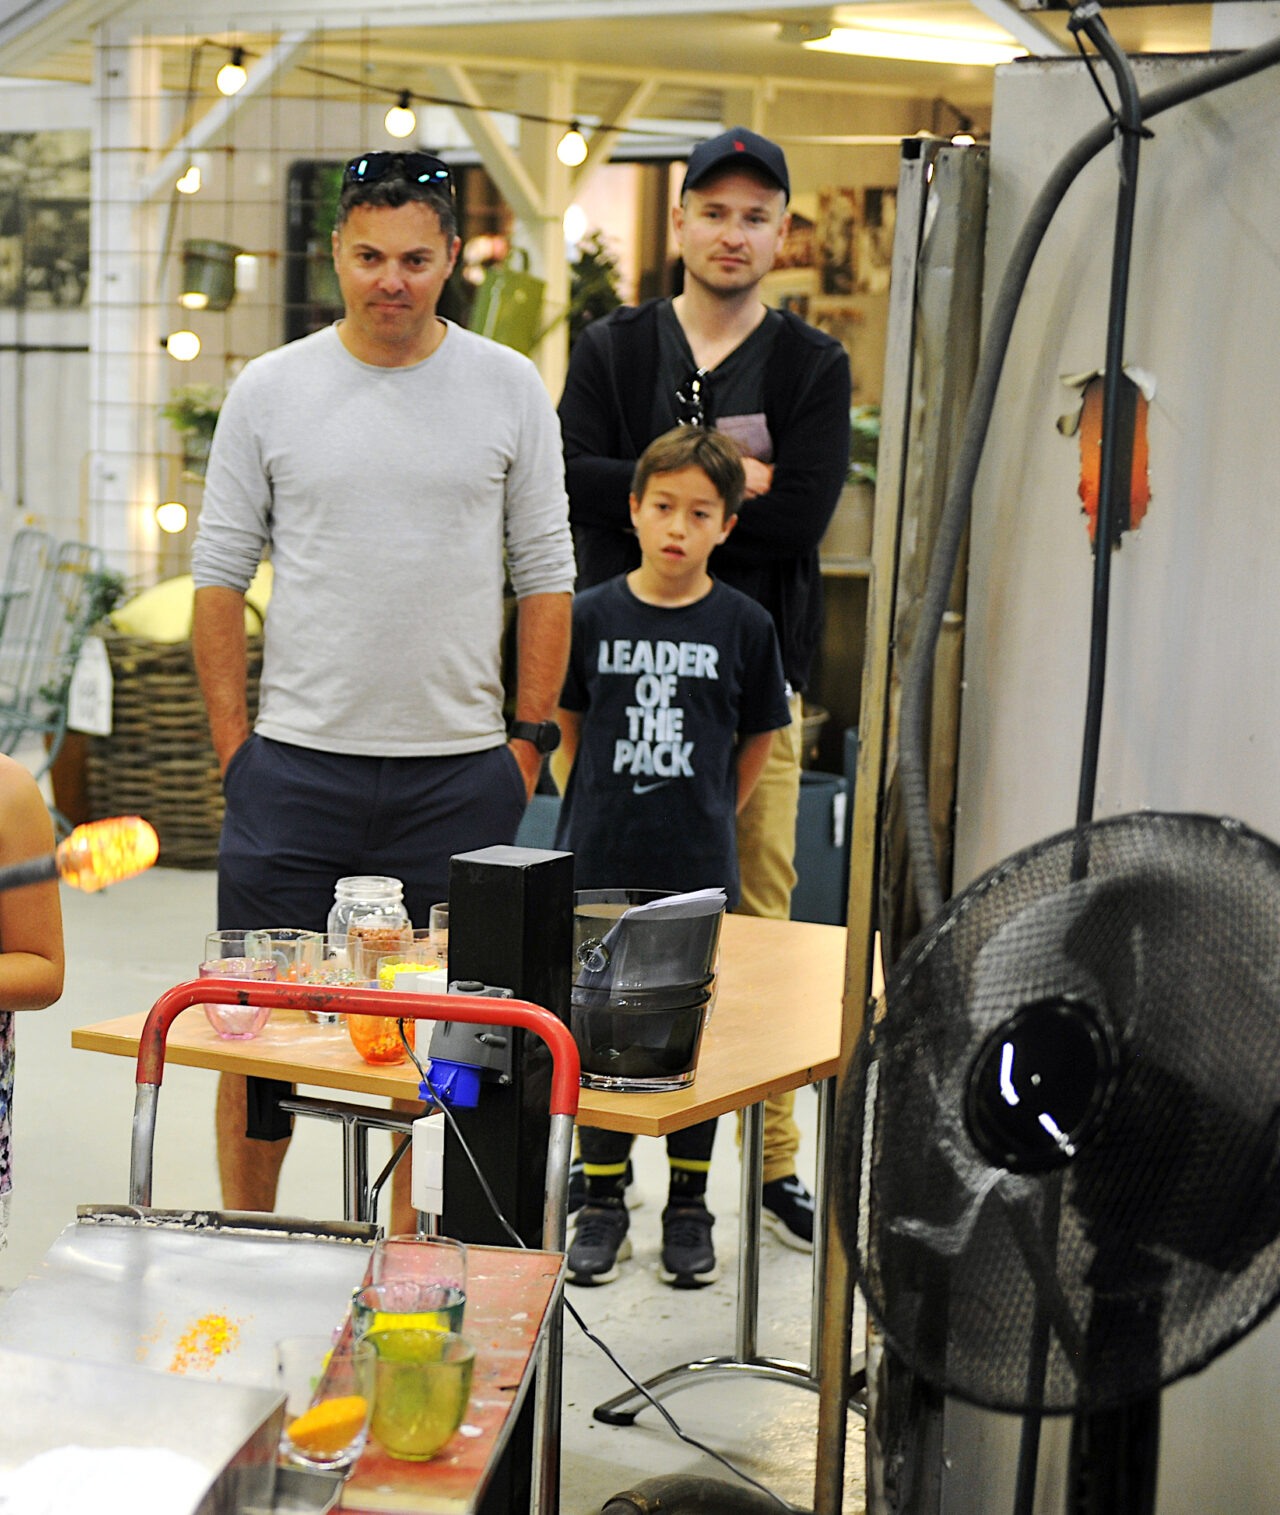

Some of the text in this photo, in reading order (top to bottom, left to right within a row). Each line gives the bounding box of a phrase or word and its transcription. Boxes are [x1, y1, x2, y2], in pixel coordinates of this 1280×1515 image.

[598, 639, 719, 680] LEADER
[635, 674, 678, 708] OF
[625, 706, 684, 742] THE
[612, 739, 695, 778] PACK
